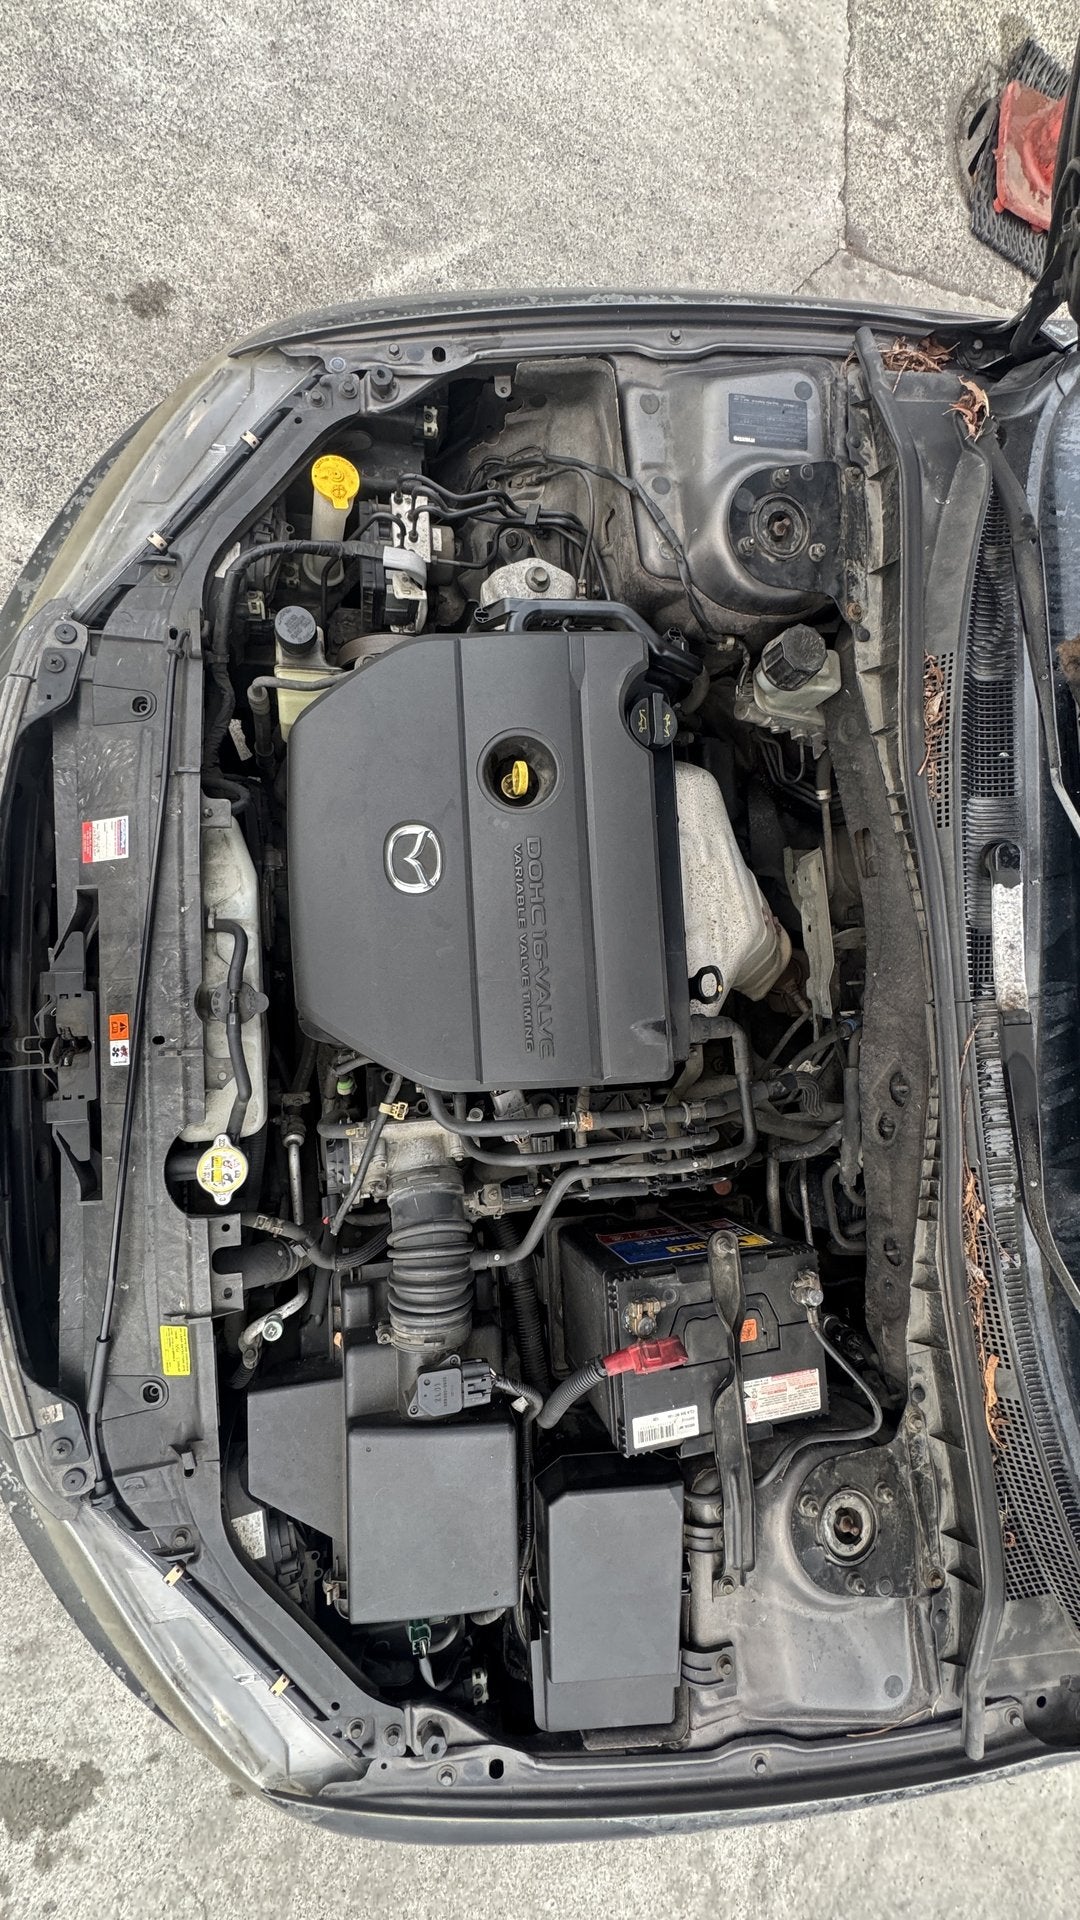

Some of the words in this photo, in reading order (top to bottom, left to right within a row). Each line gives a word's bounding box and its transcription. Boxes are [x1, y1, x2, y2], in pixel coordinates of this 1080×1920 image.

[513, 843, 527, 928] VARIABLE
[526, 836, 546, 926] DOHC
[519, 934, 531, 987] VALVE
[532, 929, 555, 1059] 16-VALVE
[521, 990, 534, 1053] TIMING
